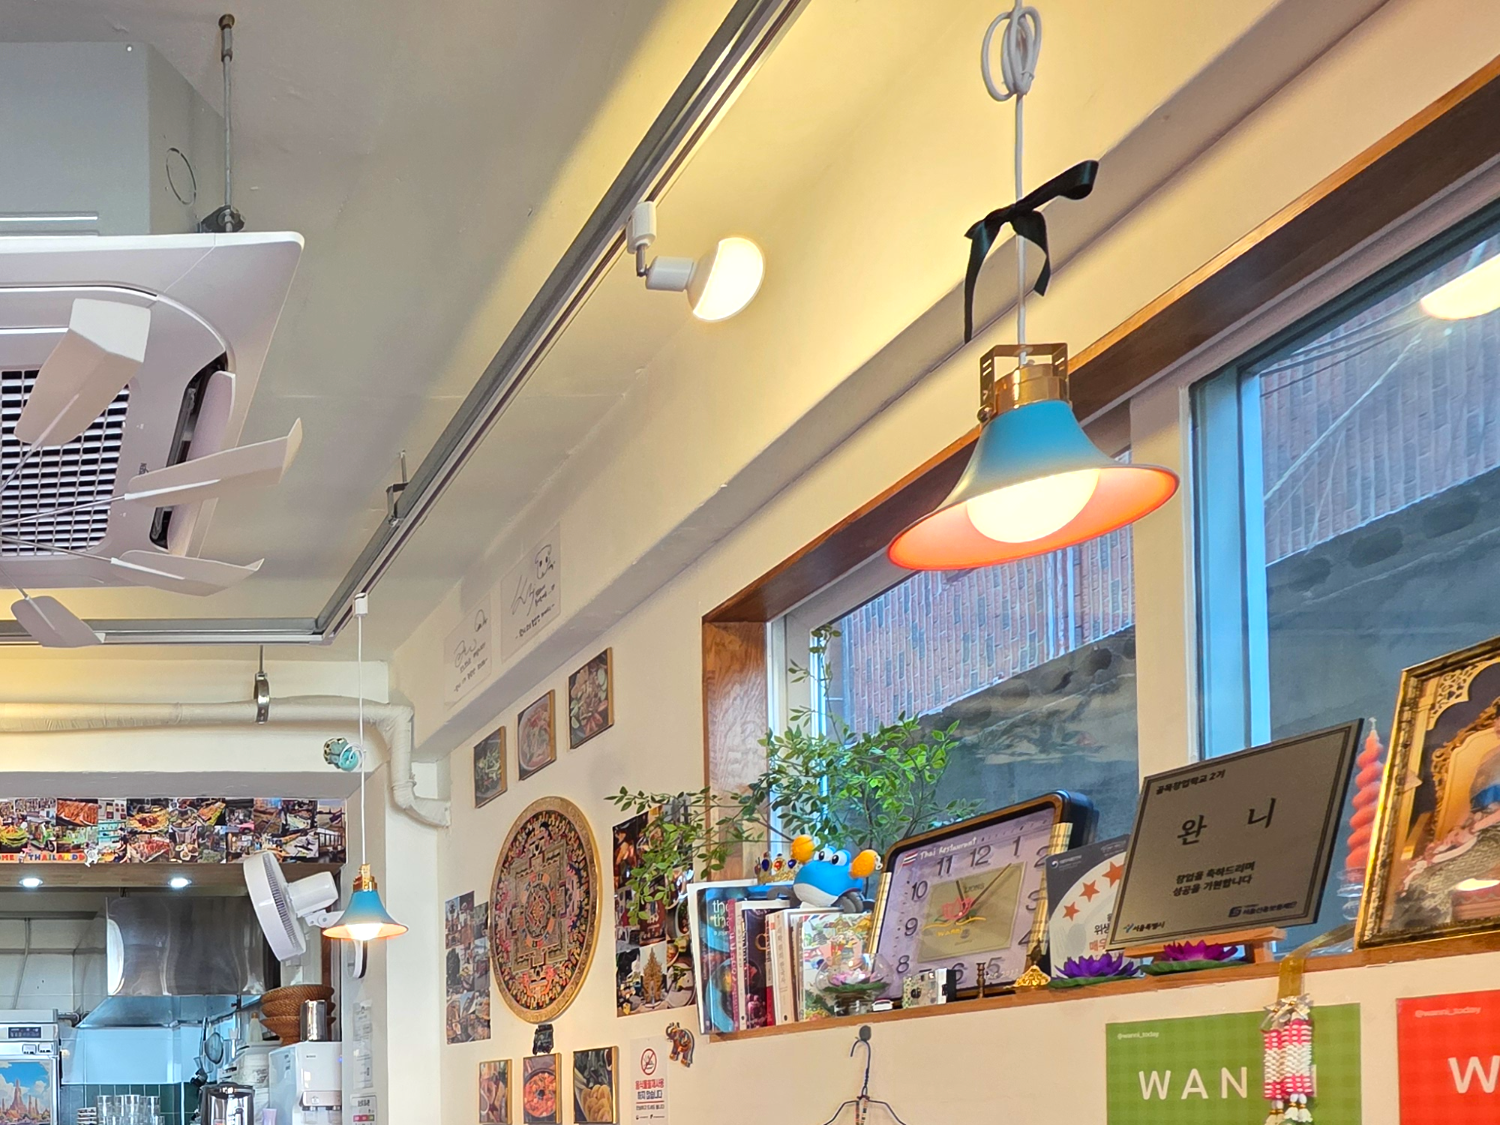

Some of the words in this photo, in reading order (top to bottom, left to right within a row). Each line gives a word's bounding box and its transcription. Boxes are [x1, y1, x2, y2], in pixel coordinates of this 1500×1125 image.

[970, 845, 991, 867] 12
[937, 856, 953, 876] 11
[912, 881, 928, 900] 10
[905, 918, 918, 936] 9
[896, 955, 910, 974] 8
